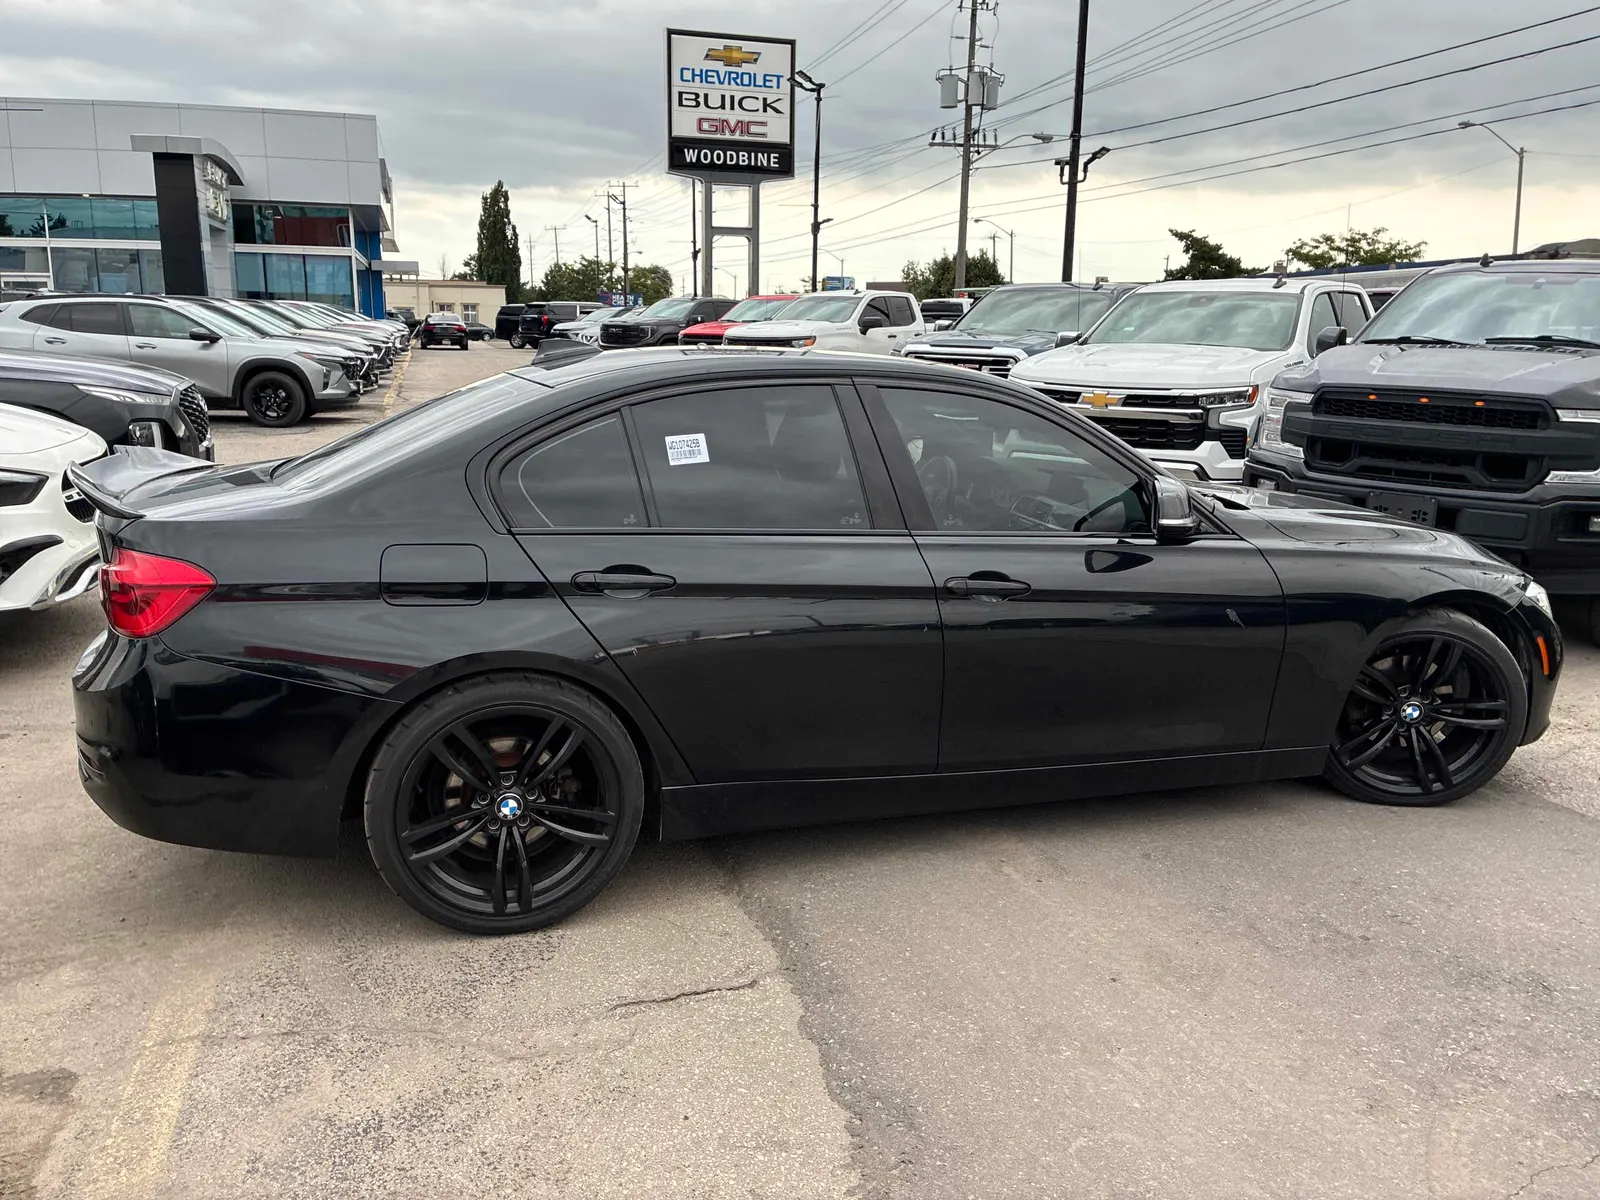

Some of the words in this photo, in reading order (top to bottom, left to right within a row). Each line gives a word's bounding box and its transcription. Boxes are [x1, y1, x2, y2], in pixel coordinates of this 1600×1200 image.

[680, 67, 784, 89] CHEVROLET
[678, 91, 785, 114] BUICK
[697, 117, 768, 138] GMC
[684, 149, 780, 167] WOODBINE
